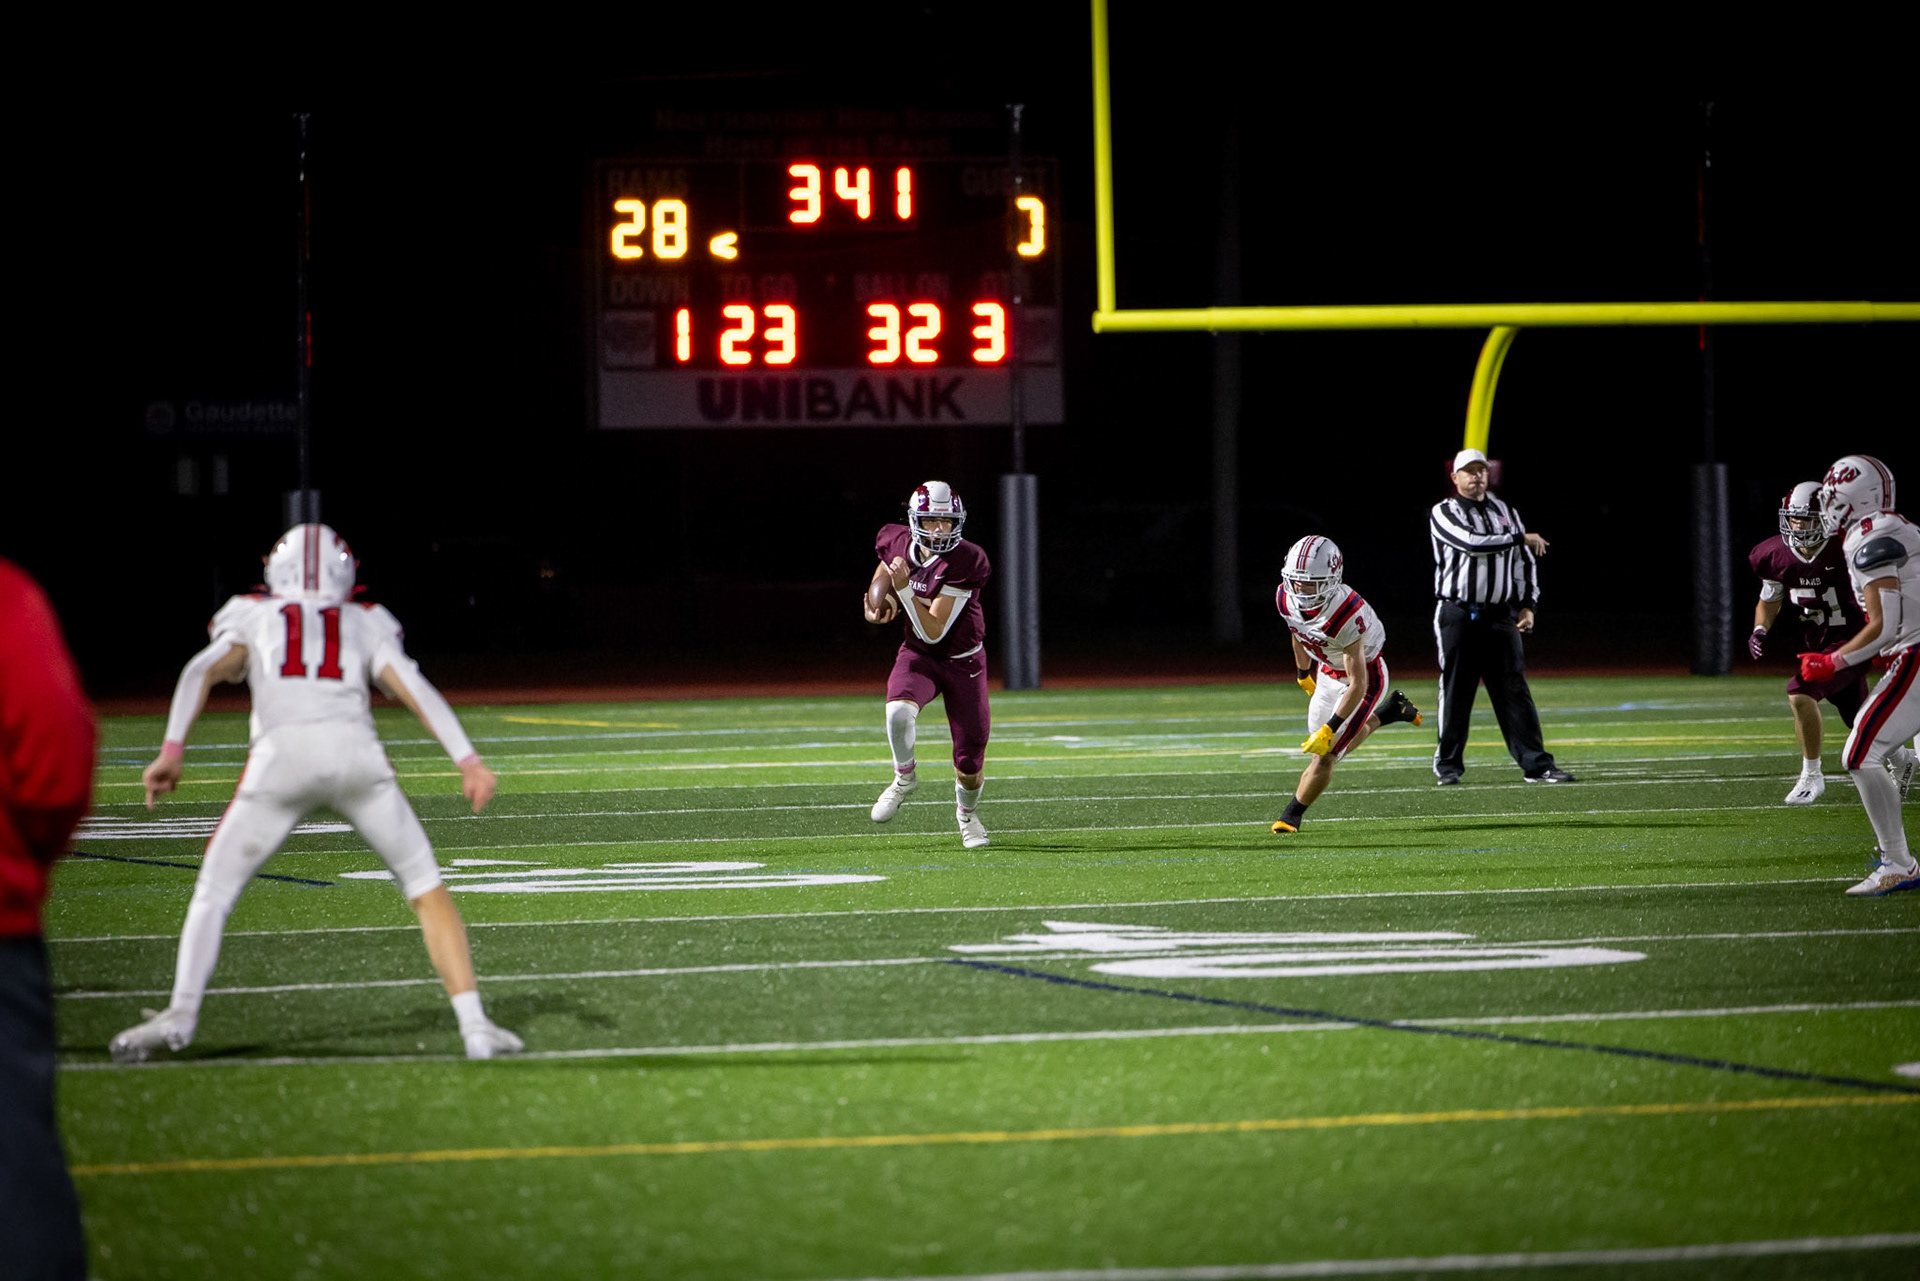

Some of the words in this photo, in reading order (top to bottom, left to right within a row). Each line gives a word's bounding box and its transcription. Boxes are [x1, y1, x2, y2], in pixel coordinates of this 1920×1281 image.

[611, 199, 689, 260] 28
[610, 273, 690, 302] DOWN
[675, 307, 692, 362] 1
[719, 304, 797, 365] 23
[867, 302, 942, 364] 32
[972, 302, 1007, 363] 3
[185, 400, 298, 422] Gaudette
[698, 376, 966, 422] UNIBANK
[1354, 615, 1366, 635] 3
[1789, 587, 1846, 626] 51
[279, 603, 344, 680] 11
